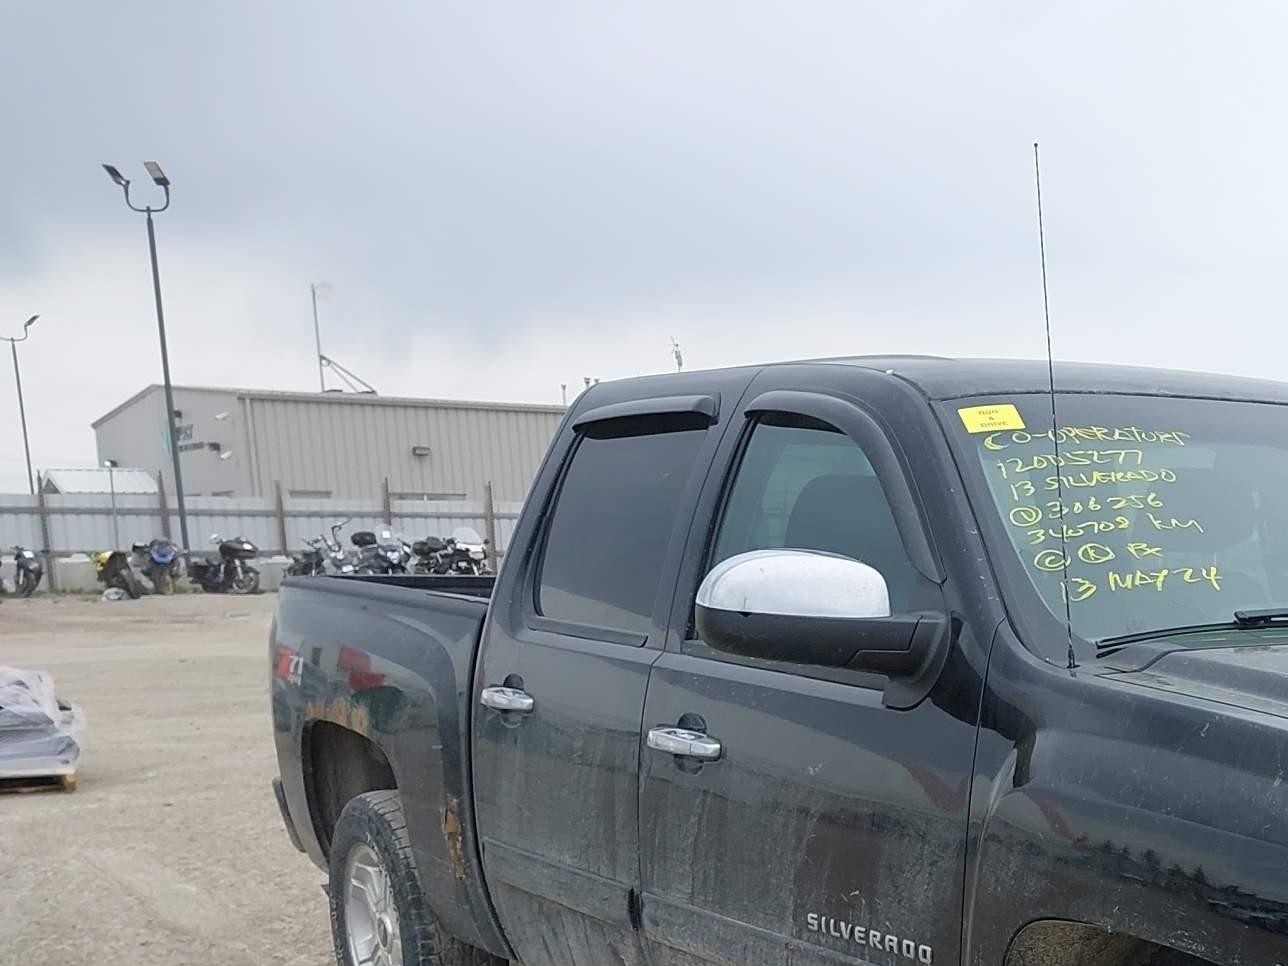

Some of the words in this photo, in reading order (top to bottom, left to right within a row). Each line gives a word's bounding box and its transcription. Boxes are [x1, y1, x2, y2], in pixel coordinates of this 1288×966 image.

[1011, 480, 1035, 500] 13
[1044, 468, 1176, 490] SILVERADO
[1060, 577, 1097, 604] 13
[1108, 569, 1168, 592] MAY
[1172, 567, 1224, 592] 24
